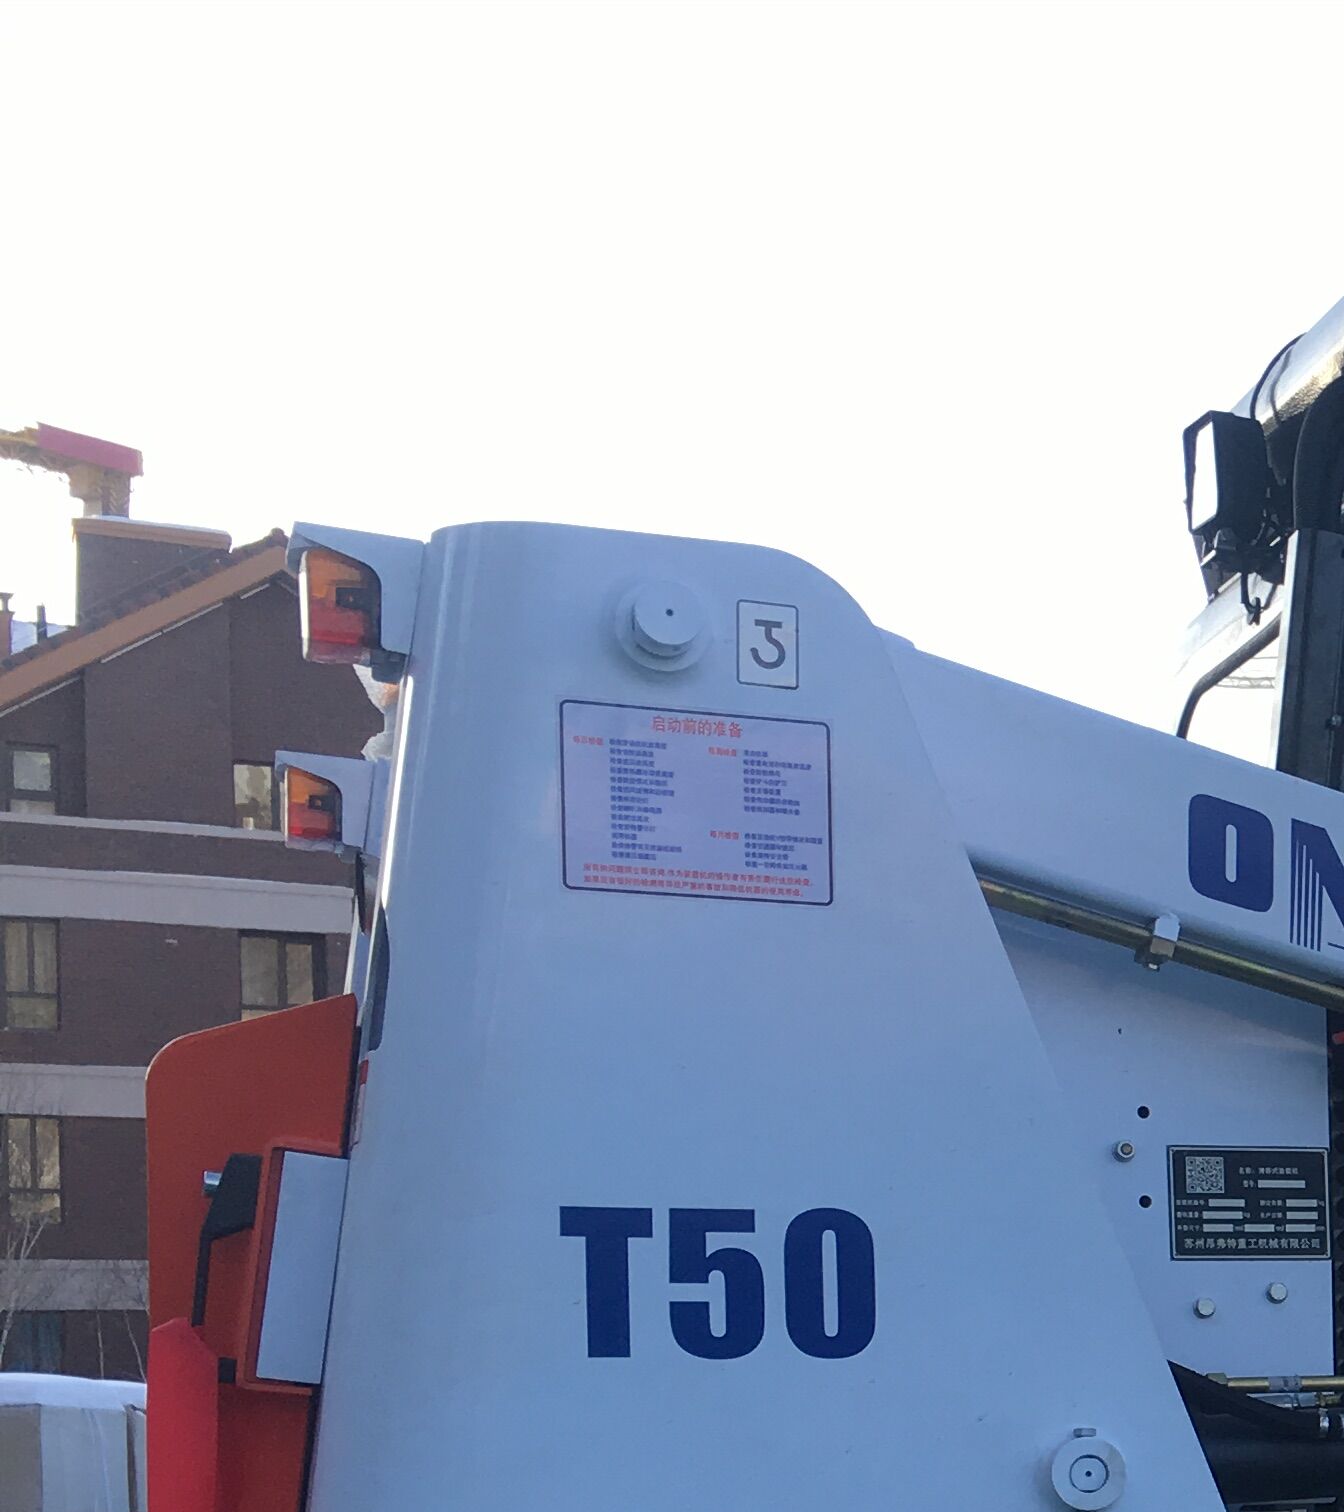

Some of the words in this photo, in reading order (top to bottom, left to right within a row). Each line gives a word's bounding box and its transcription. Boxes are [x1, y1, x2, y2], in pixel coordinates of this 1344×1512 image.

[652, 715, 743, 738] 启动前的准备
[559, 1206, 876, 1360] T50
